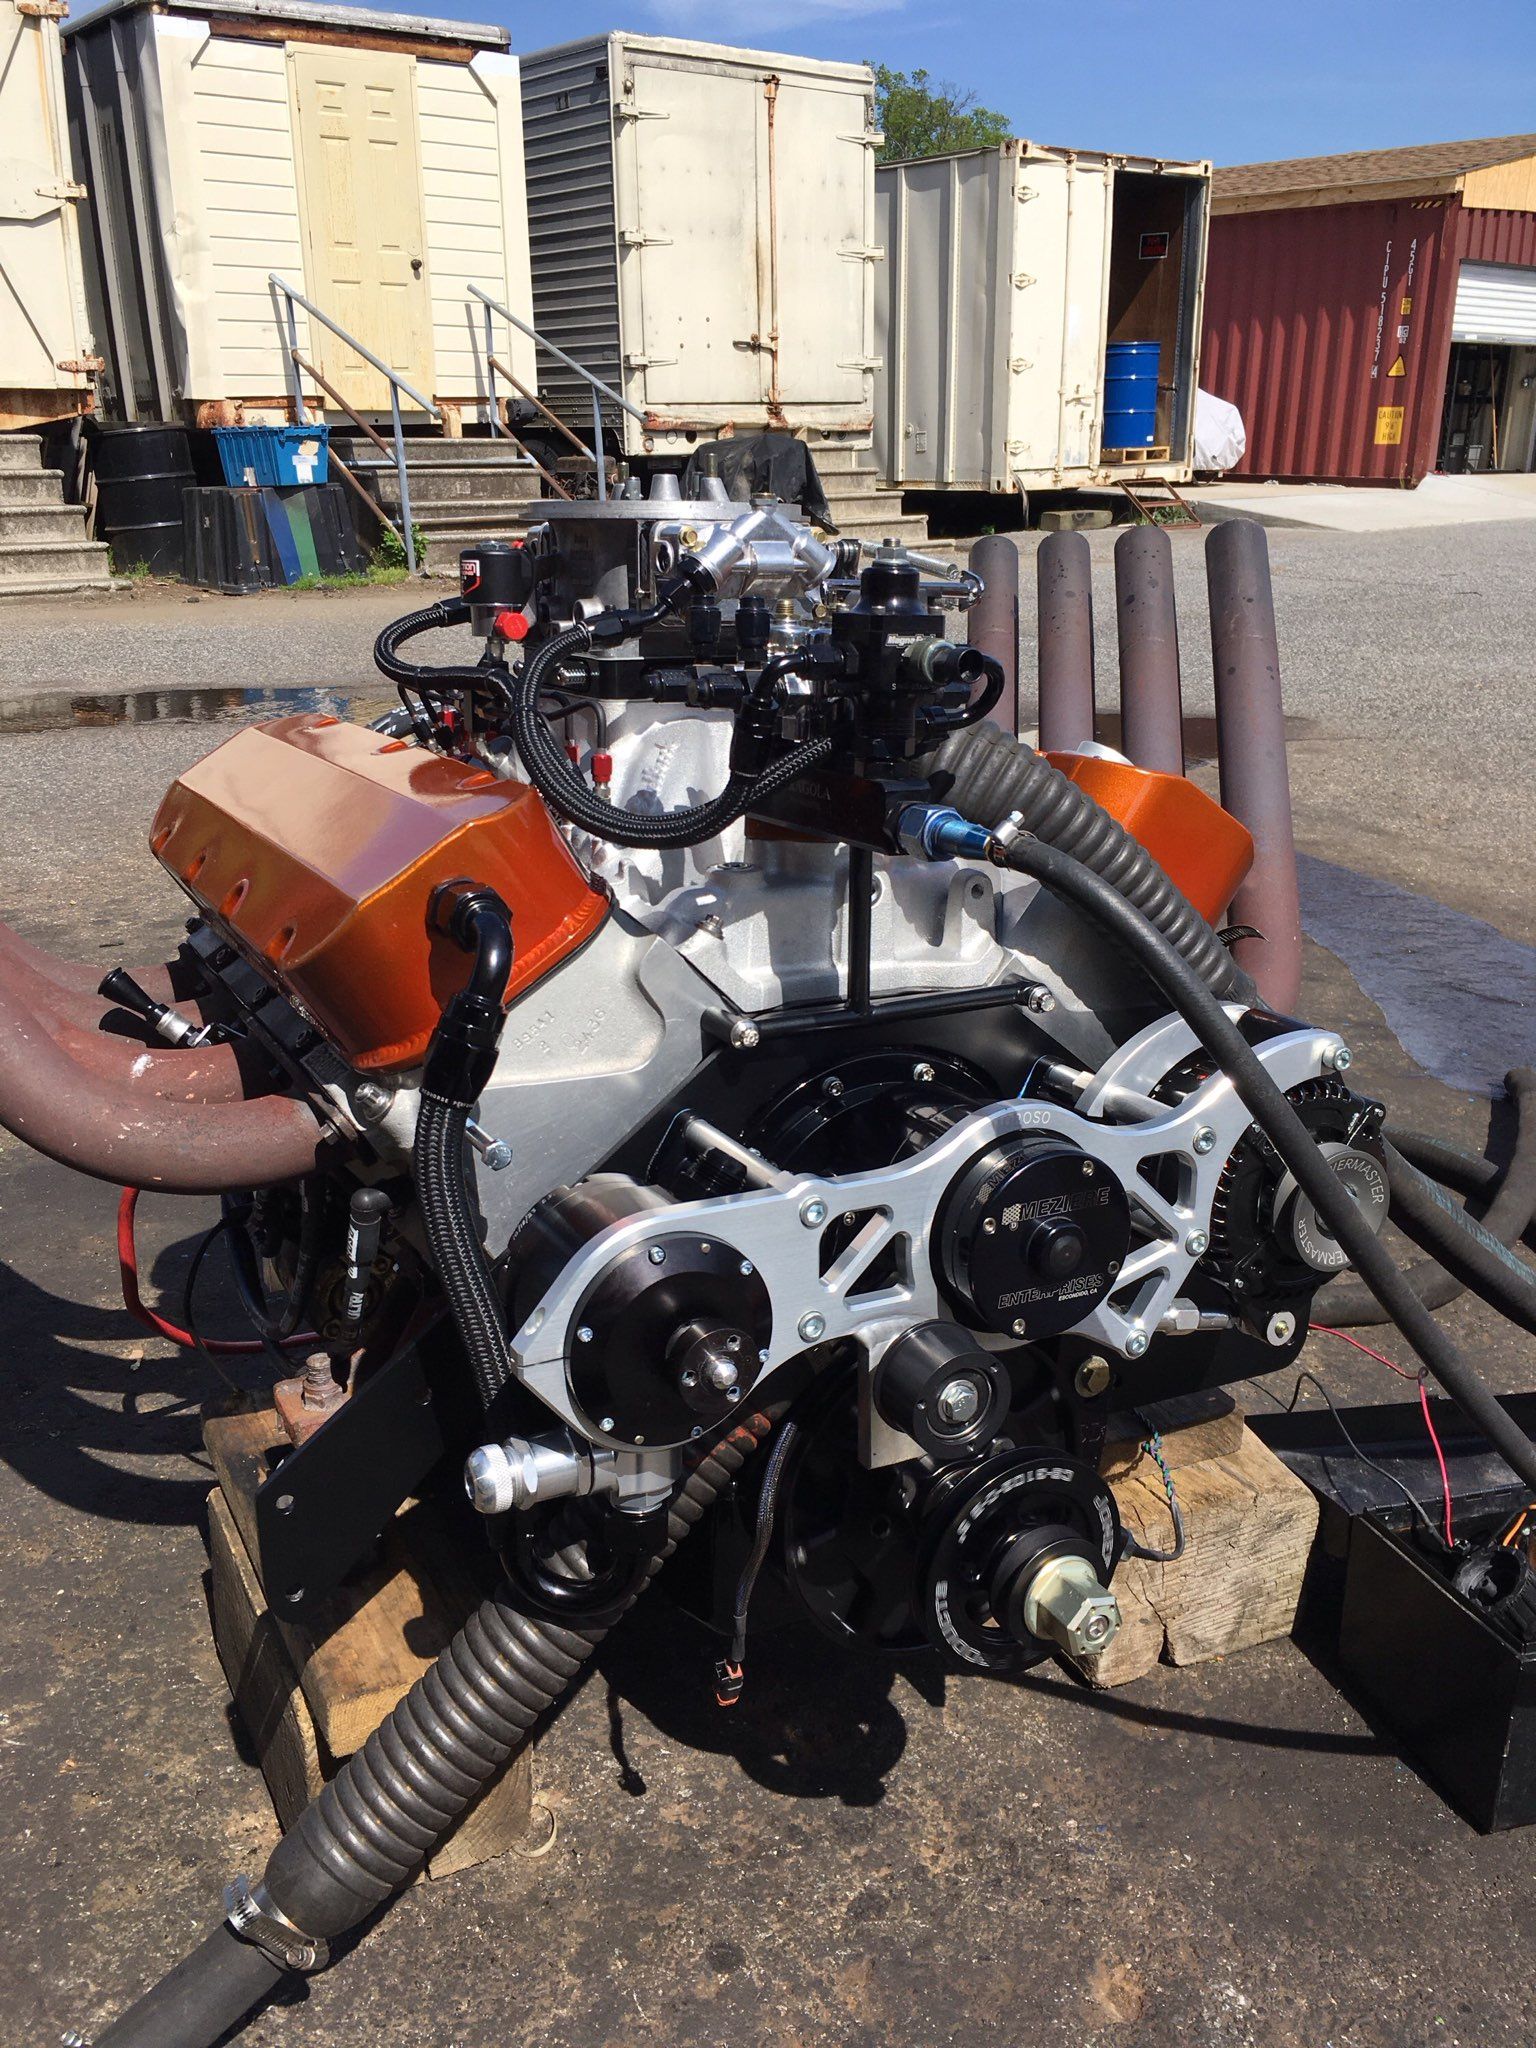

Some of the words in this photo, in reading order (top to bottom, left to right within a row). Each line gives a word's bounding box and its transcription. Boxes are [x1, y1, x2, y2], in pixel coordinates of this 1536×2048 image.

[1382, 240, 1392, 288] CIPU
[1408, 239, 1417, 286] 45G1
[1374, 292, 1386, 361] 518237
[1019, 1186, 1111, 1222] MEZIERE
